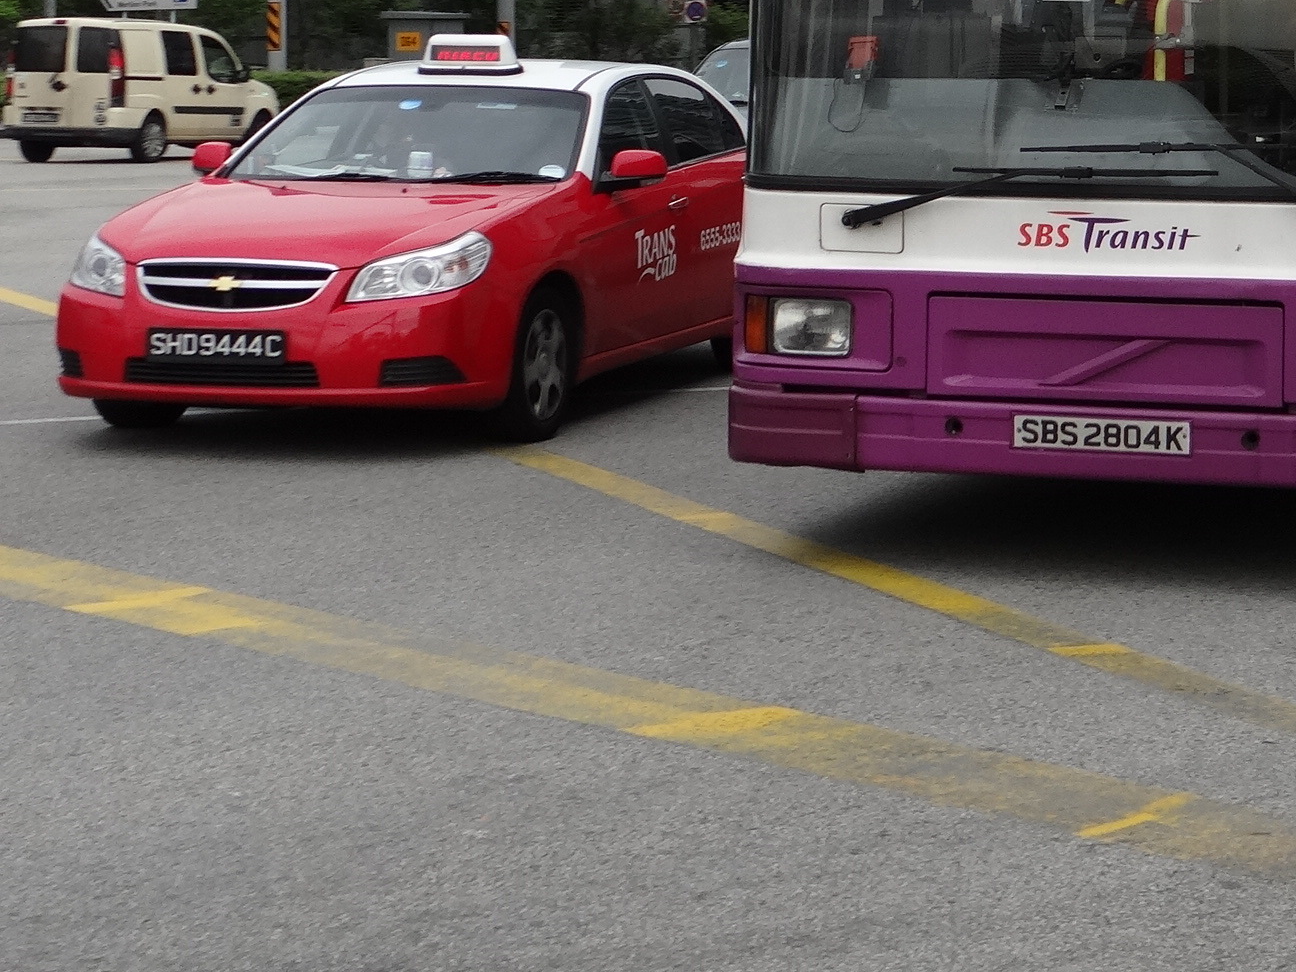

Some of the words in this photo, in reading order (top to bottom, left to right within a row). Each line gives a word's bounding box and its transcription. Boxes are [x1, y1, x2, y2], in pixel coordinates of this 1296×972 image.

[700, 221, 741, 251] 6555-3333
[1017, 222, 1071, 248] SBS
[1066, 216, 1202, 254] Transit
[150, 332, 282, 358] SHD9444C
[1021, 418, 1184, 452] SBS2804K
